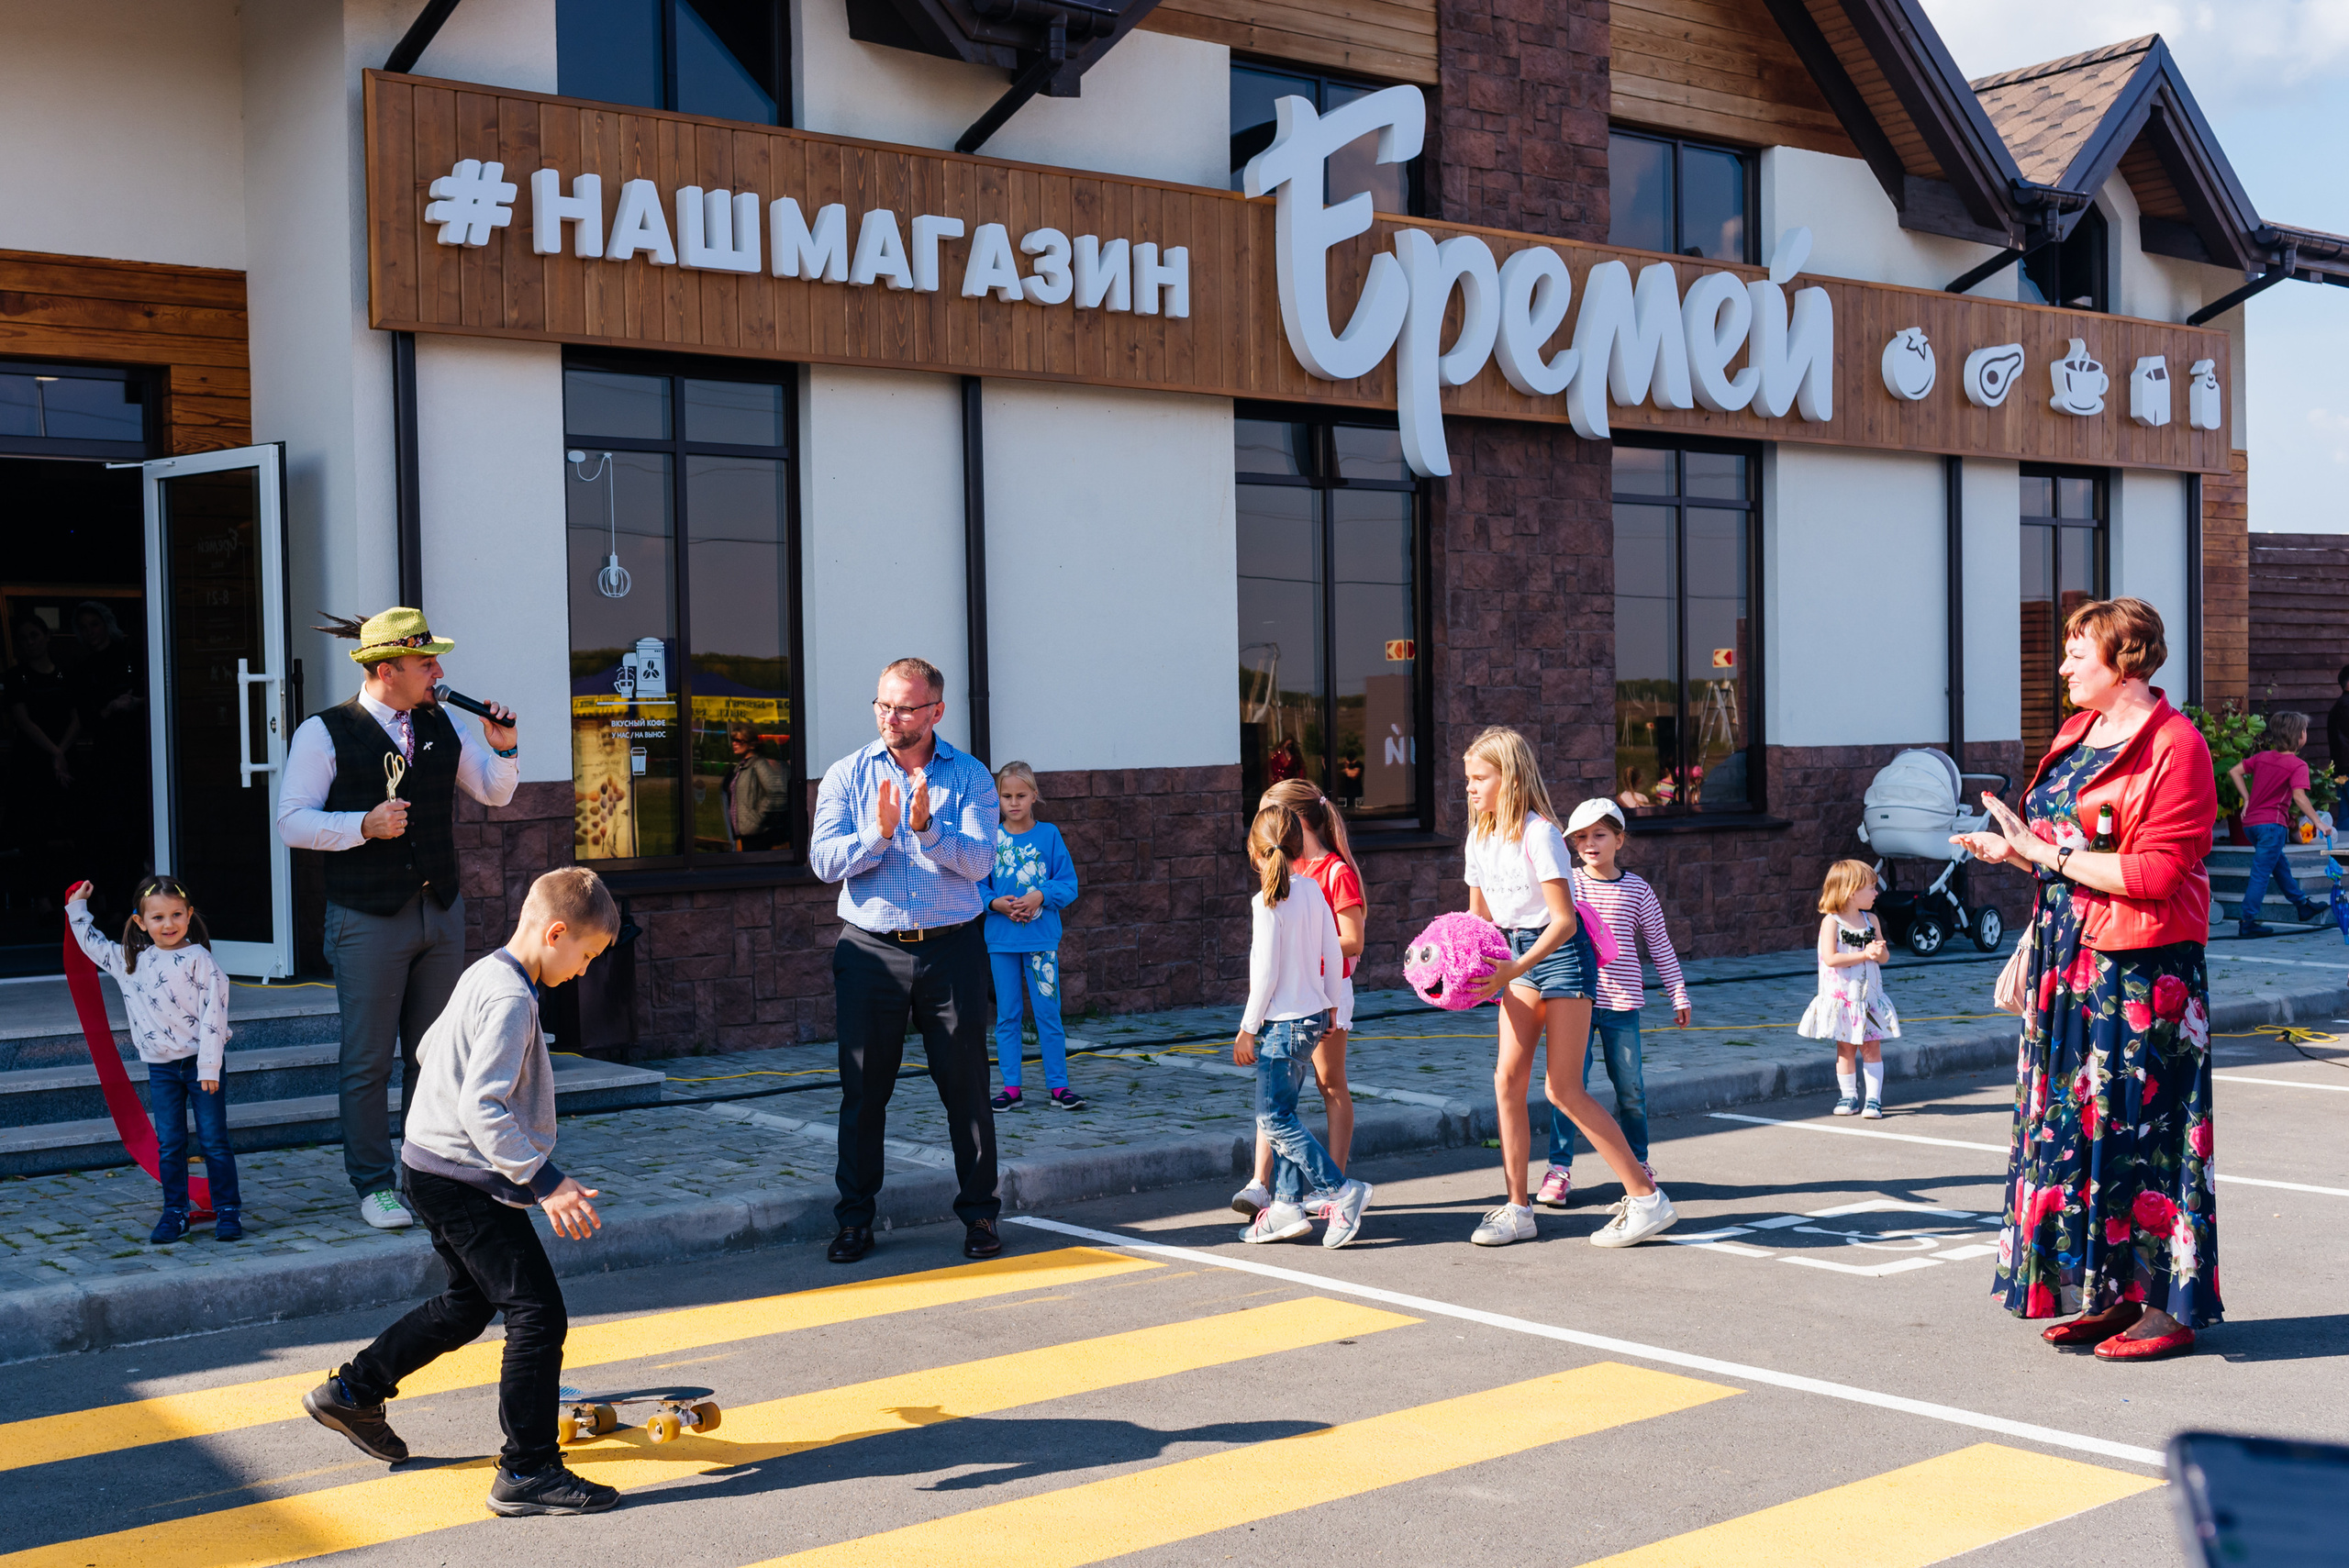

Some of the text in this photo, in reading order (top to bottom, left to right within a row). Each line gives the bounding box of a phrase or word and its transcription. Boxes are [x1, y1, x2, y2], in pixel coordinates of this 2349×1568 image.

[425, 84, 1834, 478] #НАШМАГАЗИН Еремей
[610, 717, 646, 728] ВКУСНЫЙ
